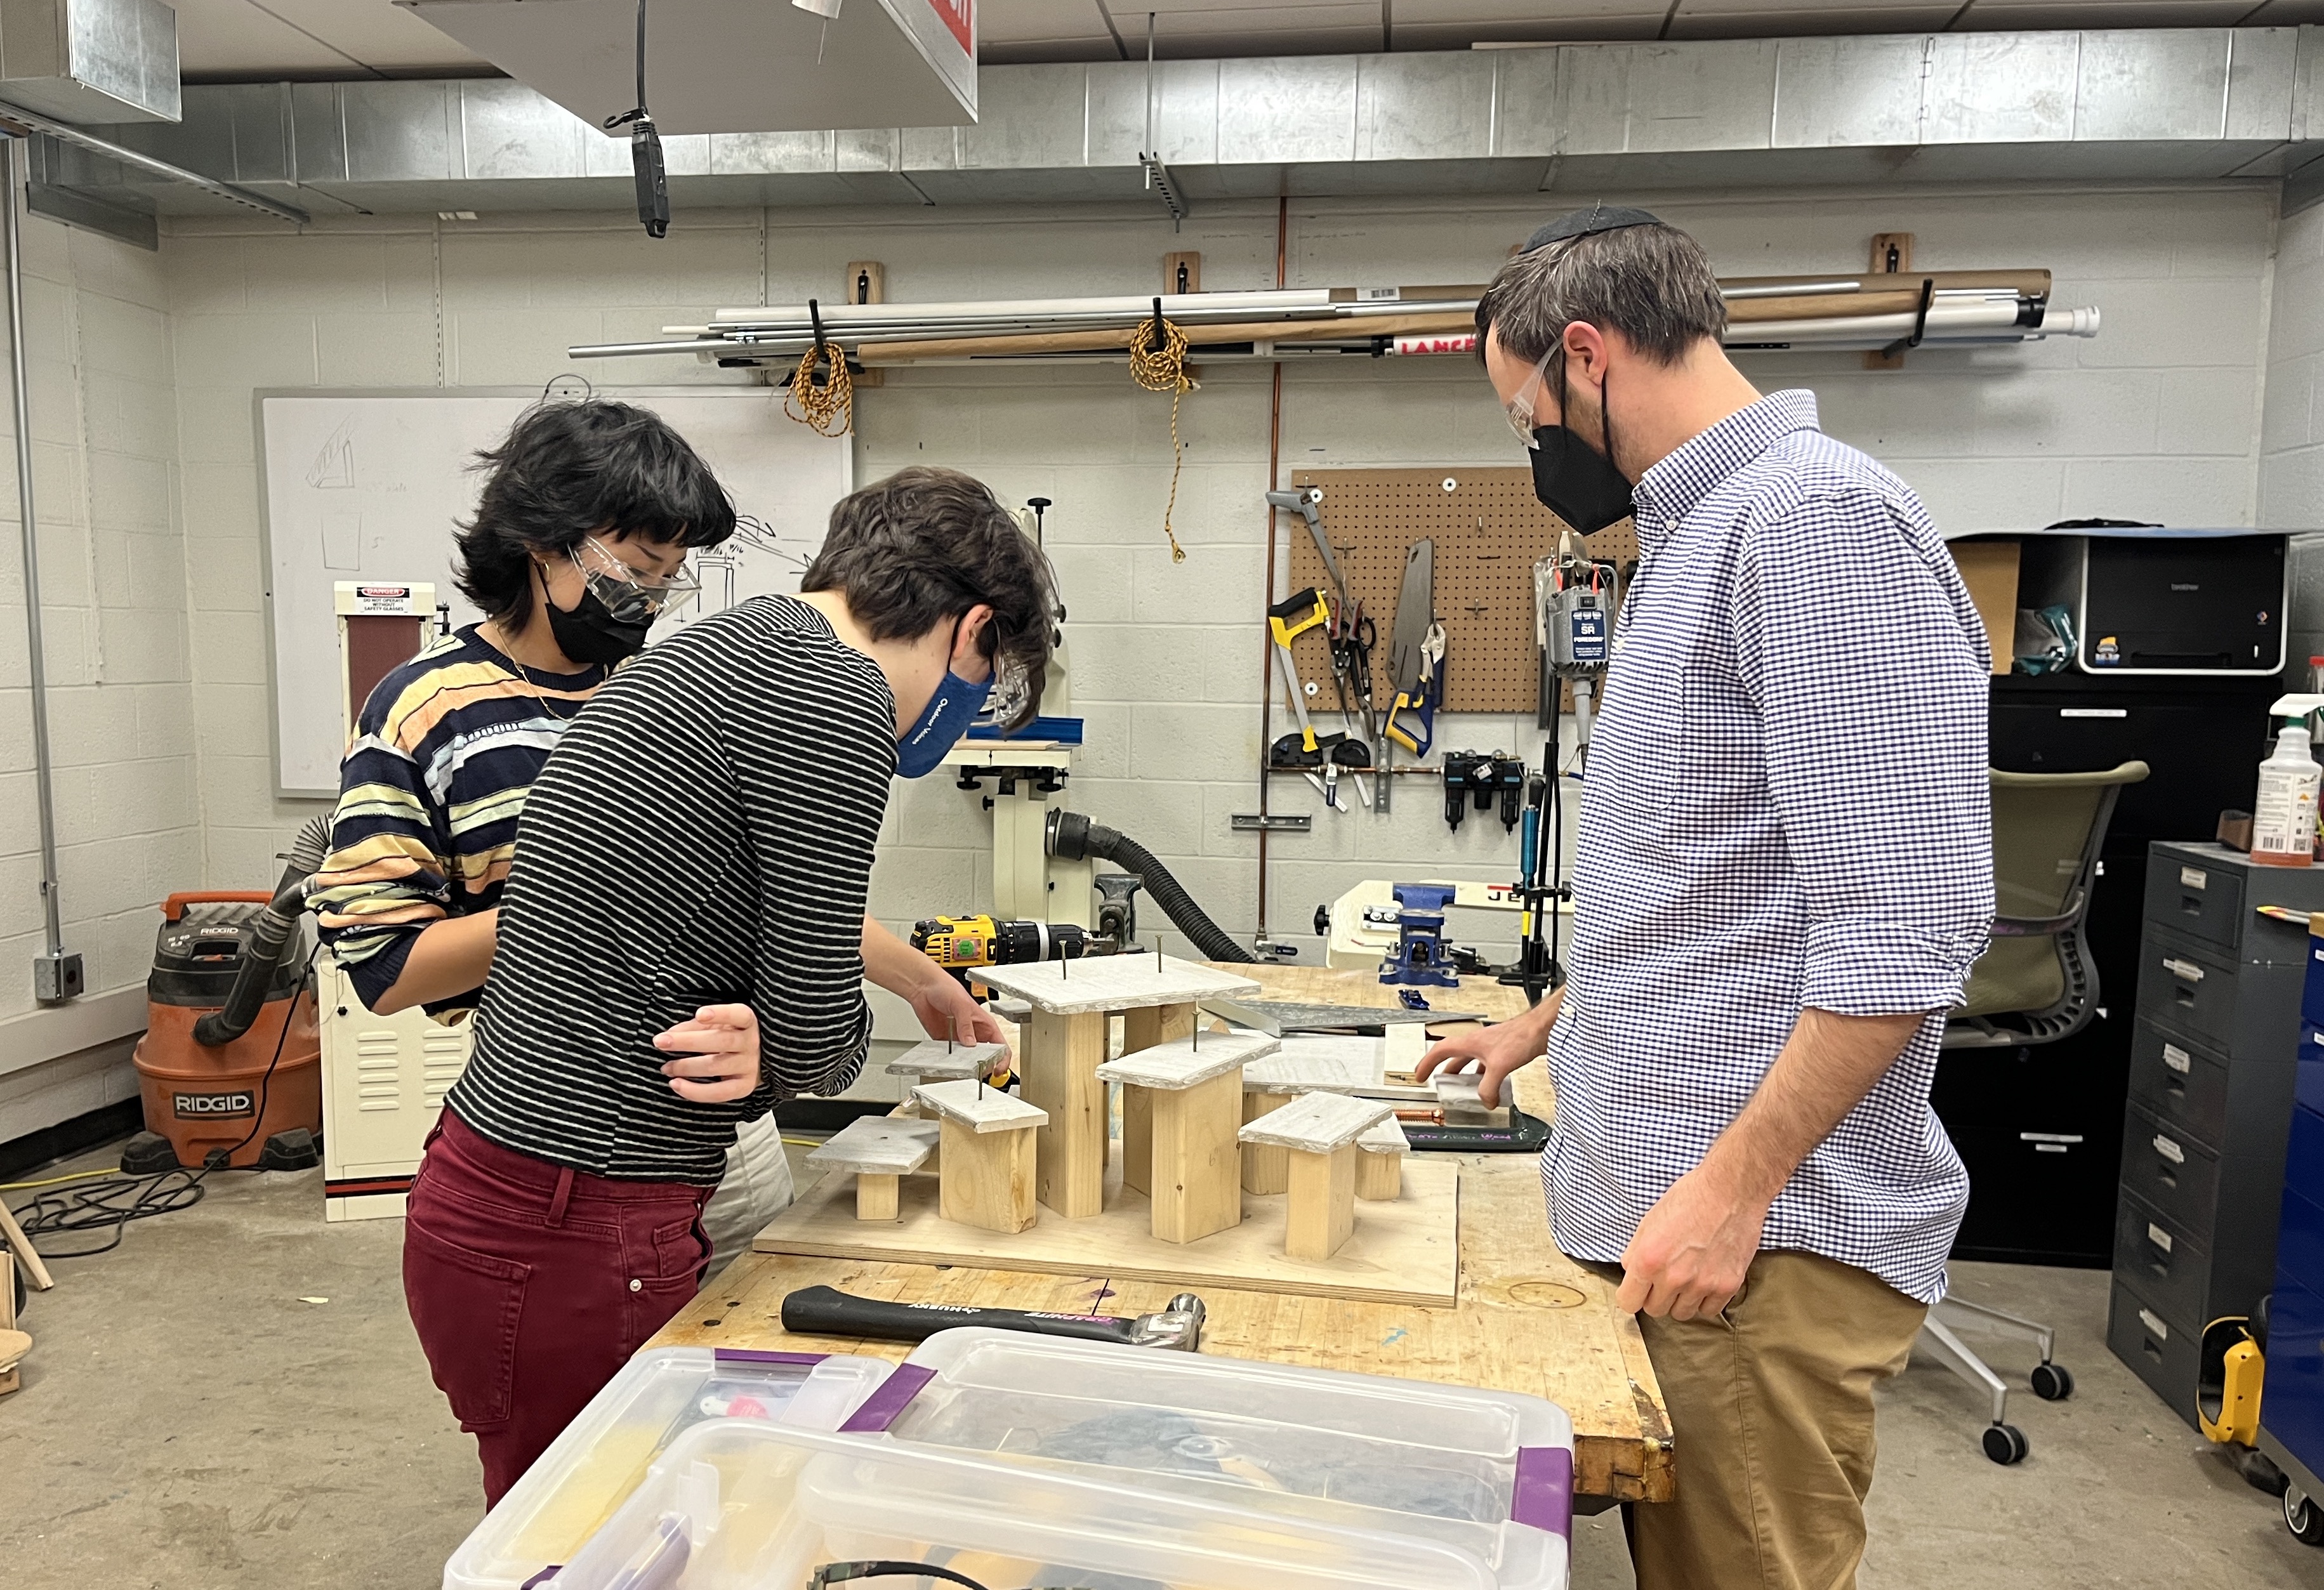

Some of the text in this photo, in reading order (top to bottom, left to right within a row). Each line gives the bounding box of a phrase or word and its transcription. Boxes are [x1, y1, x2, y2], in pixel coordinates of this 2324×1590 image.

[1581, 626, 1595, 634] SR
[928, 698, 948, 726] Outdoor
[201, 927, 239, 935] RIDGID
[176, 1094, 250, 1112] RIDGID
